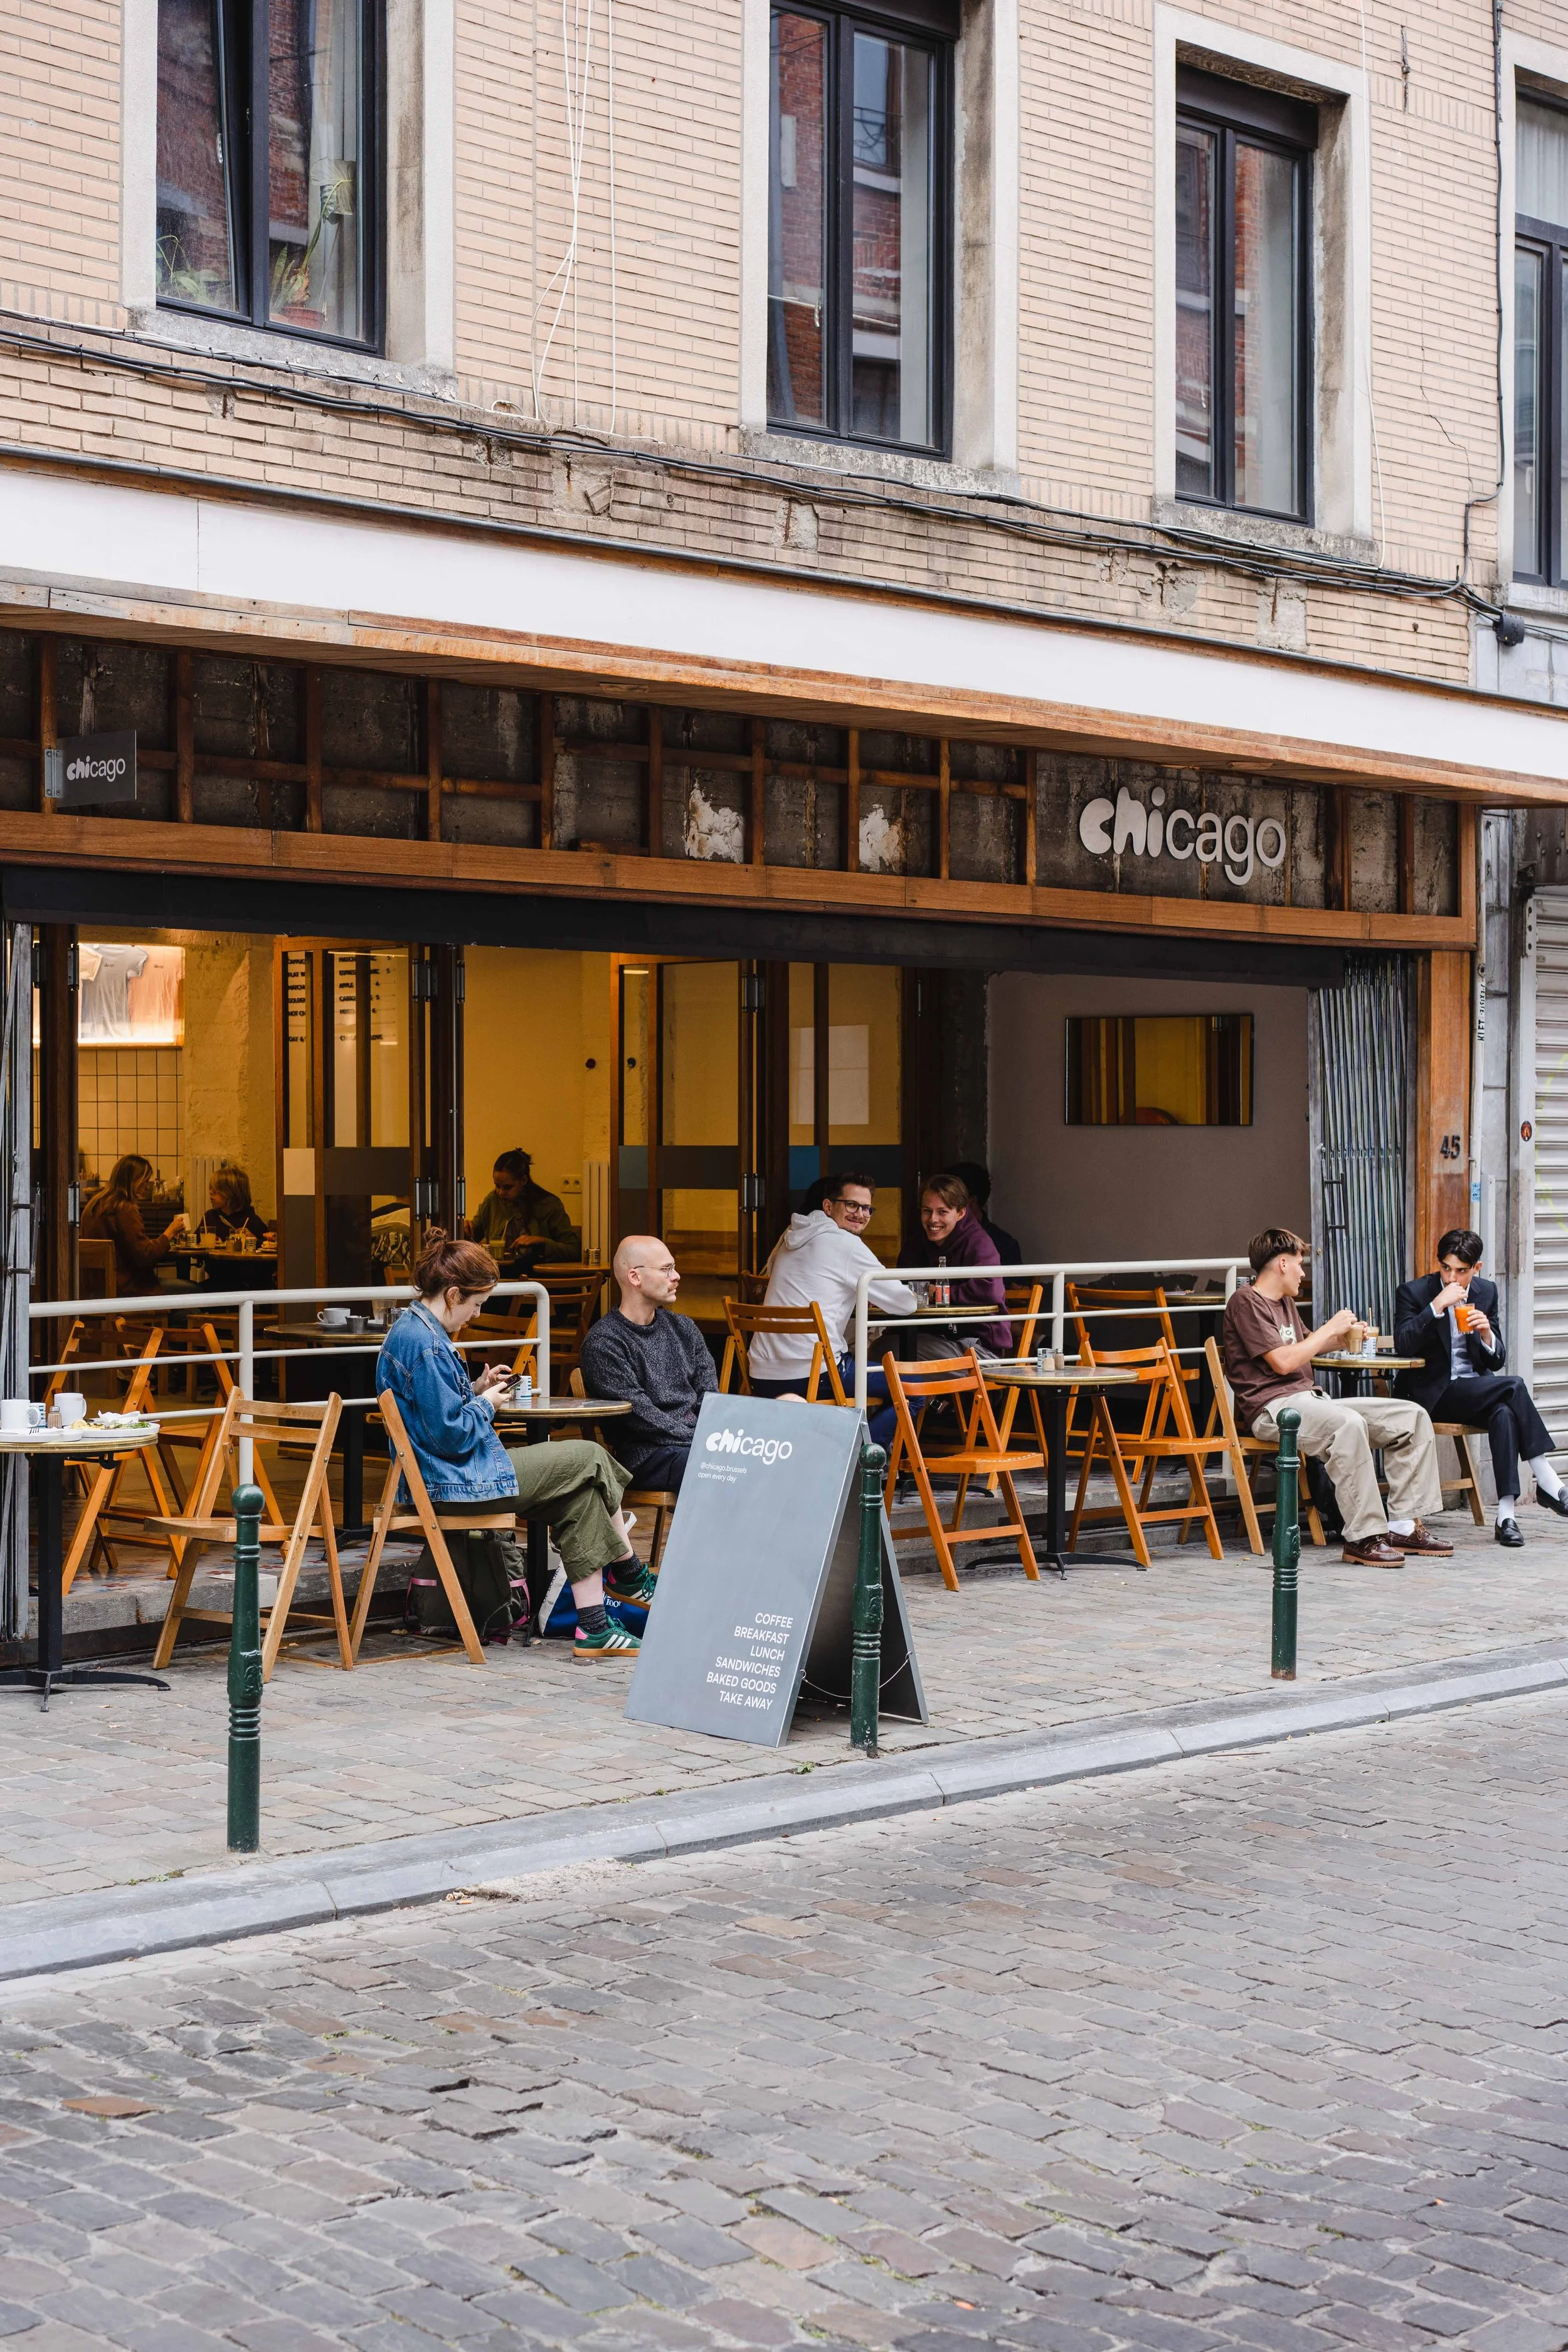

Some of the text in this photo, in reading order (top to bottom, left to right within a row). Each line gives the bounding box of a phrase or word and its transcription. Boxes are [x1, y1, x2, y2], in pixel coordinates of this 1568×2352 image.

[66, 755, 126, 782] chicago
[1079, 786, 1286, 886] chicago
[1440, 1134, 1461, 1160] 45
[706, 1428, 793, 1465] chicago
[700, 1461, 748, 1474] @chicago.brussels
[712, 1474, 726, 1482] every
[726, 1475, 737, 1483] day
[755, 1612, 793, 1629] COFFEE
[734, 1626, 790, 1645] BREAKFAST
[750, 1645, 785, 1661] LUNCH
[715, 1656, 781, 1677] SANDWICHES
[706, 1671, 777, 1694] BAKED GOODS
[719, 1690, 773, 1710] TAKE AWAY
